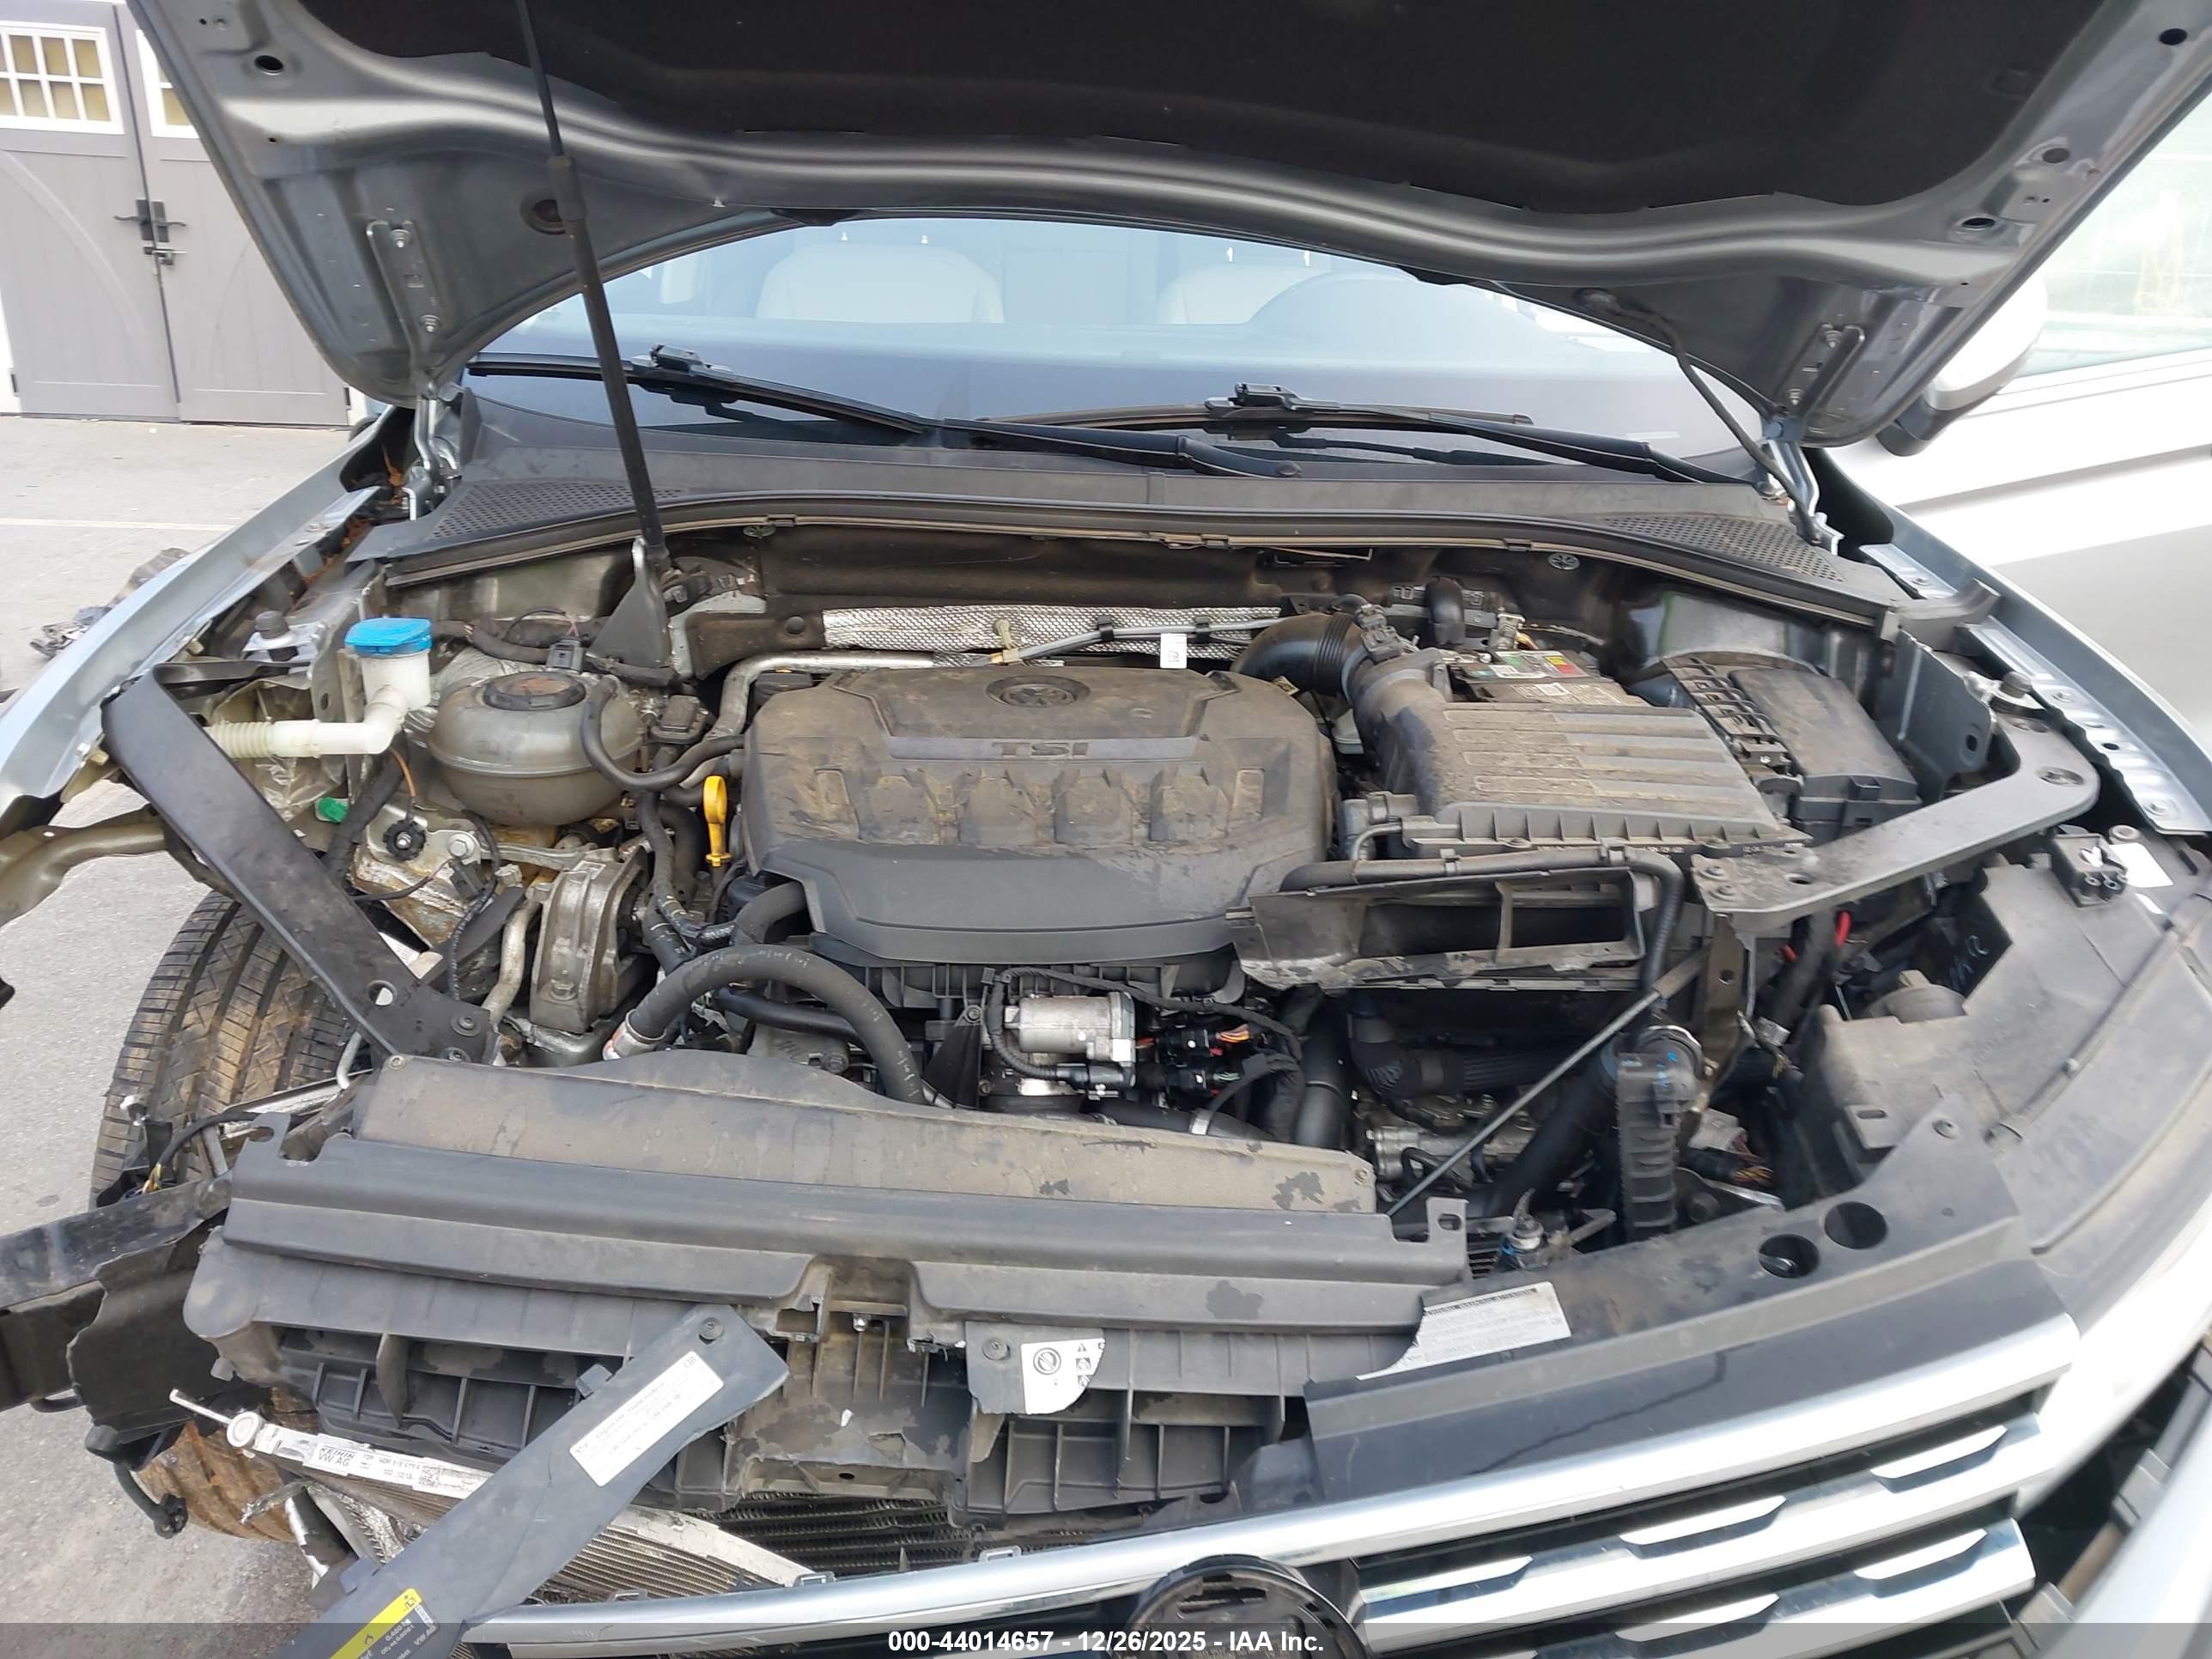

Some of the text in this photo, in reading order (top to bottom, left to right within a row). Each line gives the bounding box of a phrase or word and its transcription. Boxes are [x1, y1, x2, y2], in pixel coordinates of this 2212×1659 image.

[992, 741, 1089, 757] TSI
[319, 1446, 355, 1459] KEIHIN
[319, 1452, 334, 1462] VW
[336, 1456, 349, 1467] AG
[413, 1624, 437, 1645] VW AG
